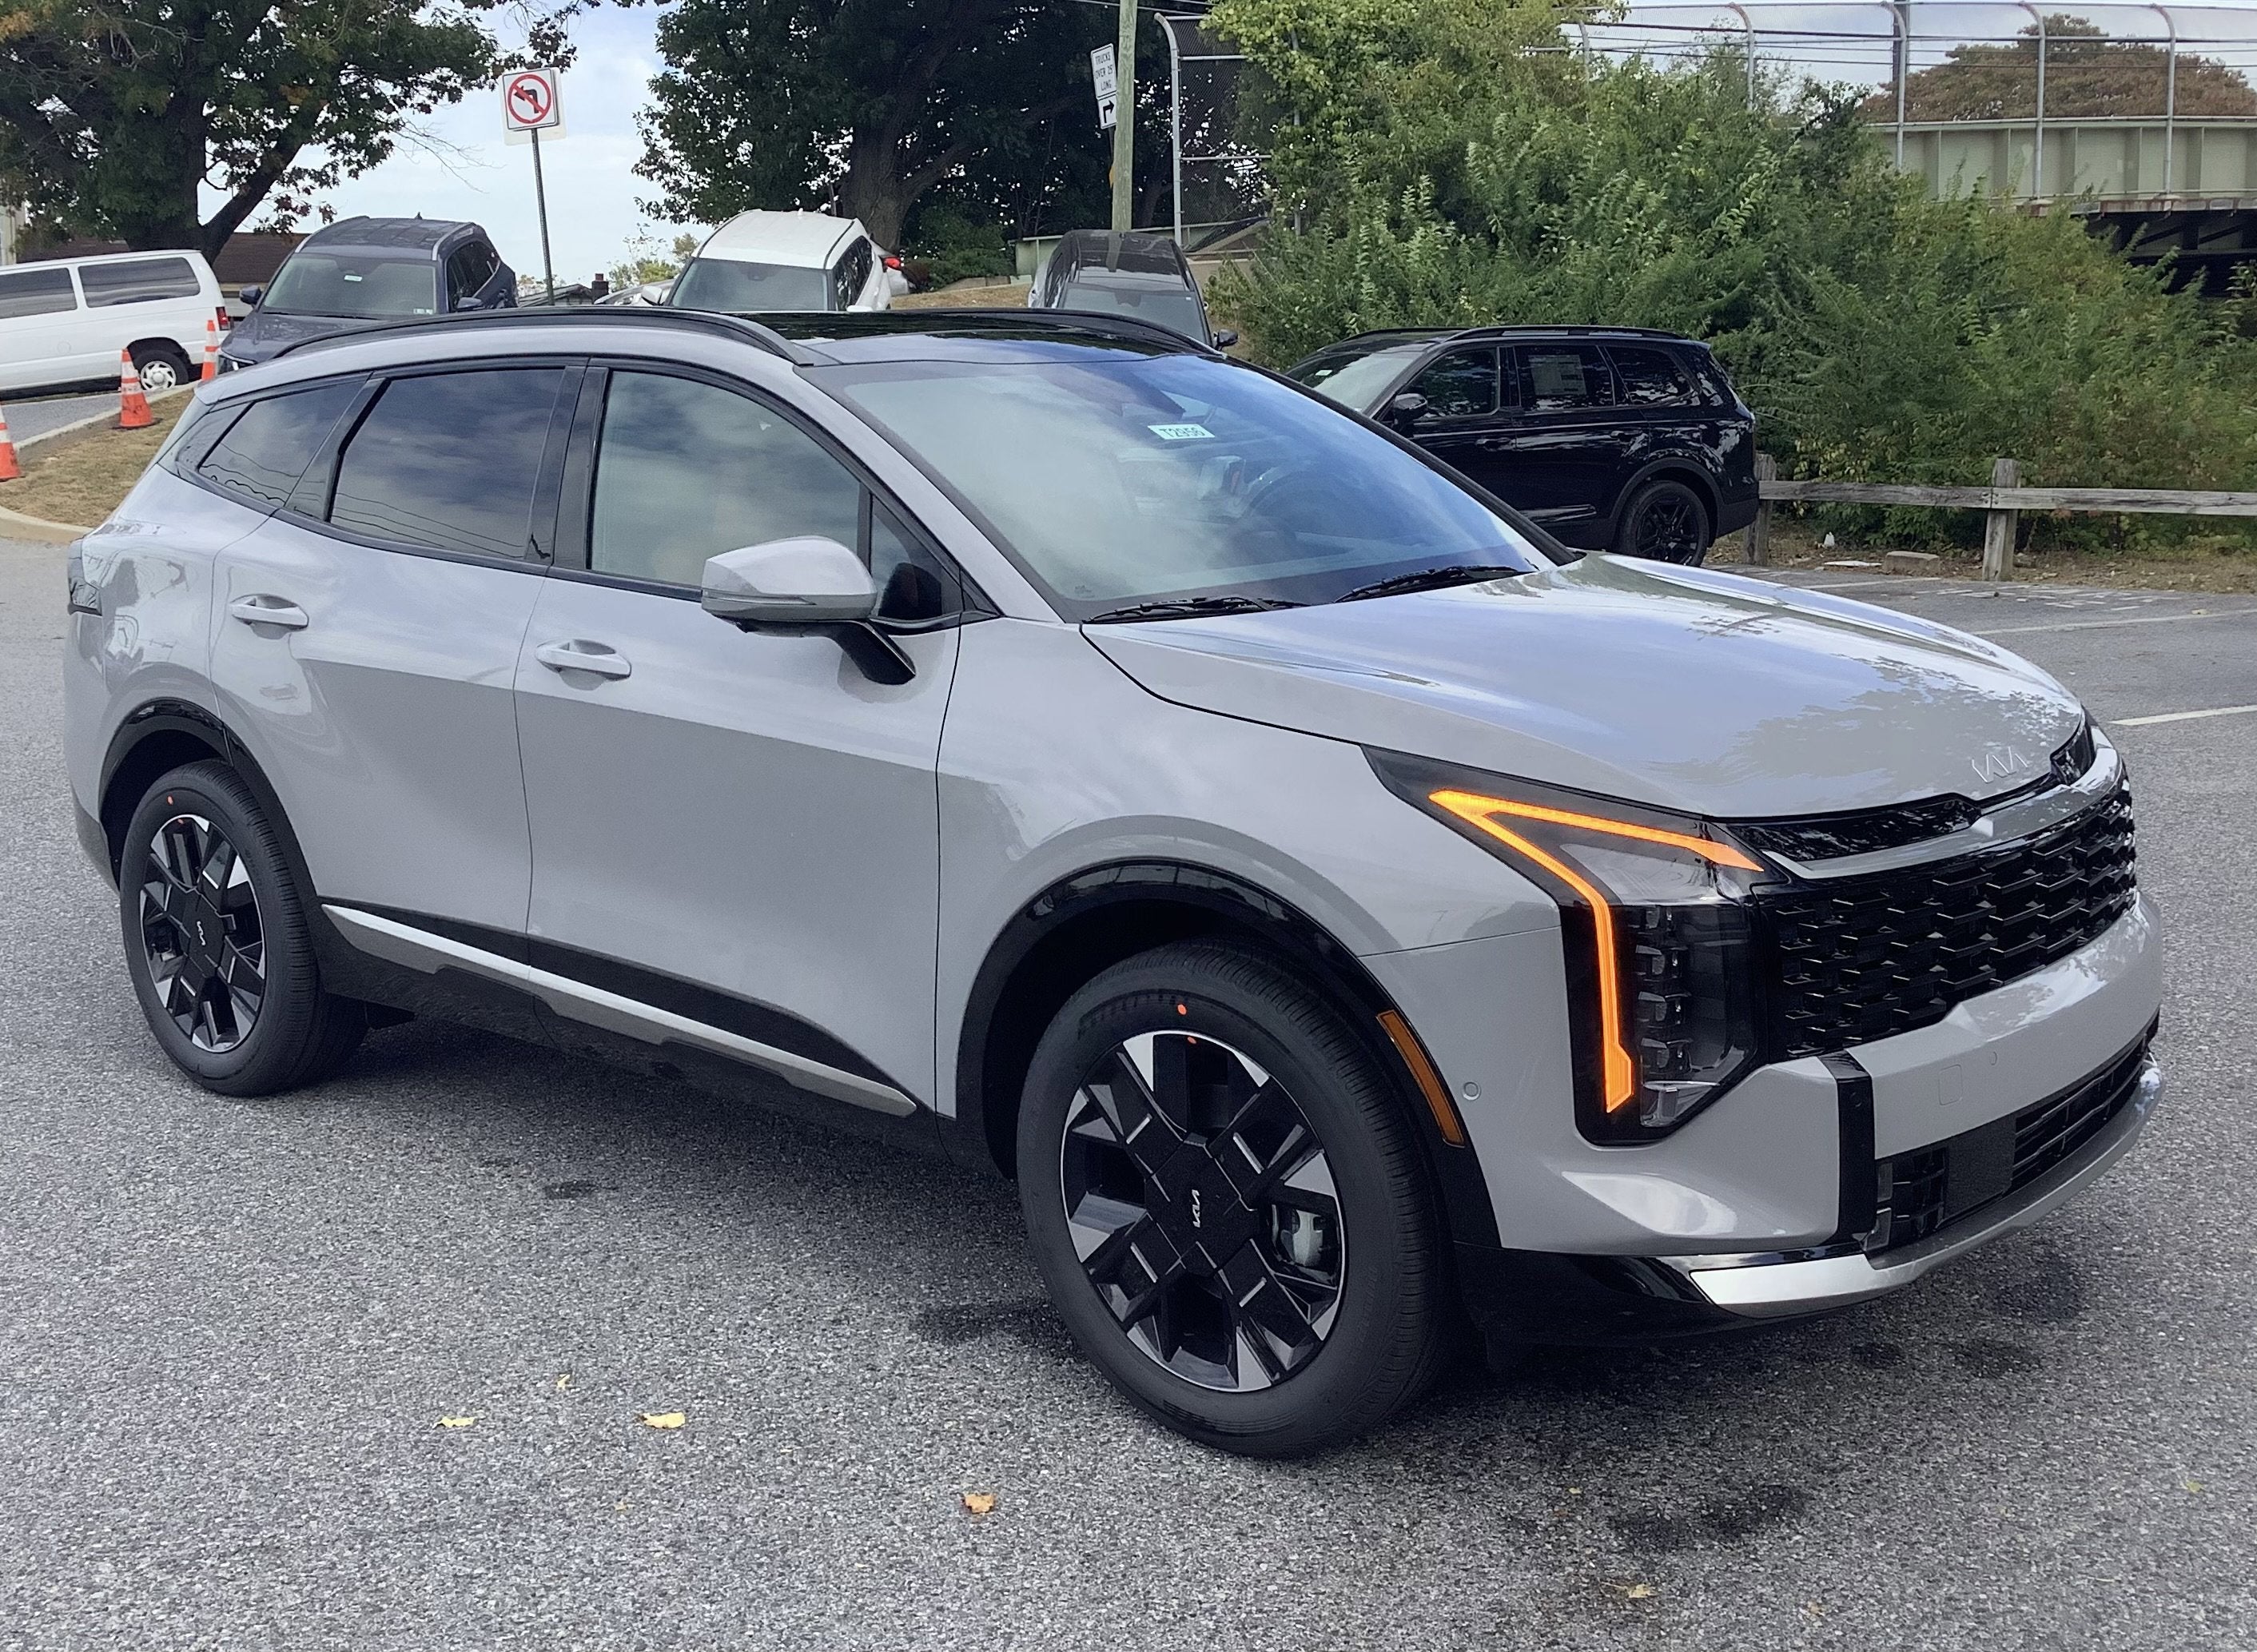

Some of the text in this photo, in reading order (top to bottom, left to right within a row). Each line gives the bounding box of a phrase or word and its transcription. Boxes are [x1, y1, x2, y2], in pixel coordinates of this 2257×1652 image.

[1095, 52, 1111, 64] TRUCKS
[1095, 67, 1106, 79] OVER
[1101, 80, 1112, 91] LONG
[1971, 746, 2029, 784] KIA
[1191, 1188, 1200, 1228] KIA
